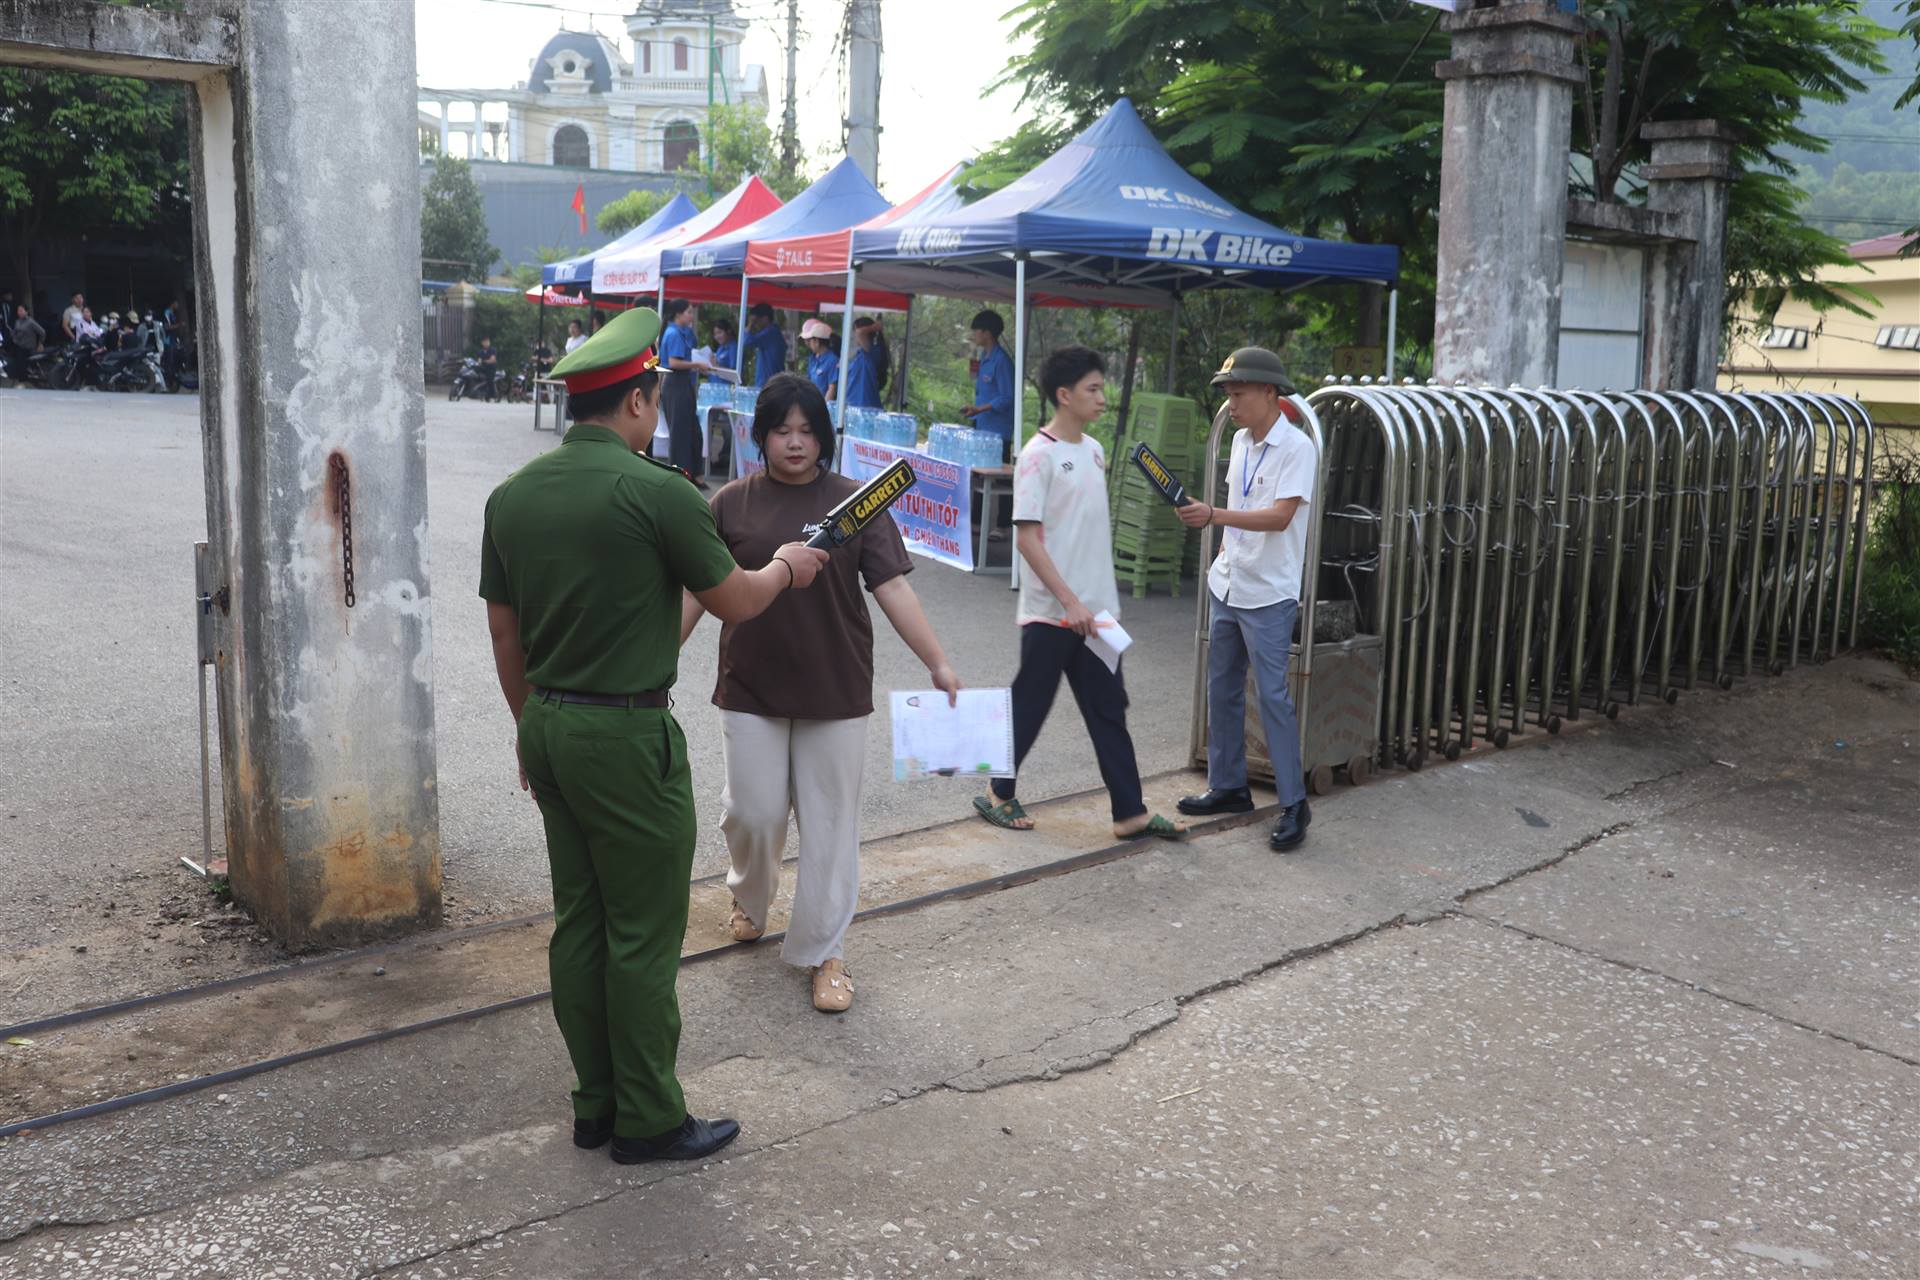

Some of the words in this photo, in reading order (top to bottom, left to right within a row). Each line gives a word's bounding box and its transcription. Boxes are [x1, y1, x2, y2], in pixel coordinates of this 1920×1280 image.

[1119, 185, 1172, 202] DK
[784, 250, 813, 267] TAILG
[1146, 226, 1214, 262] DK
[1214, 234, 1293, 267] Bike
[1141, 453, 1170, 487] GARRETT
[855, 470, 906, 518] GARRETT
